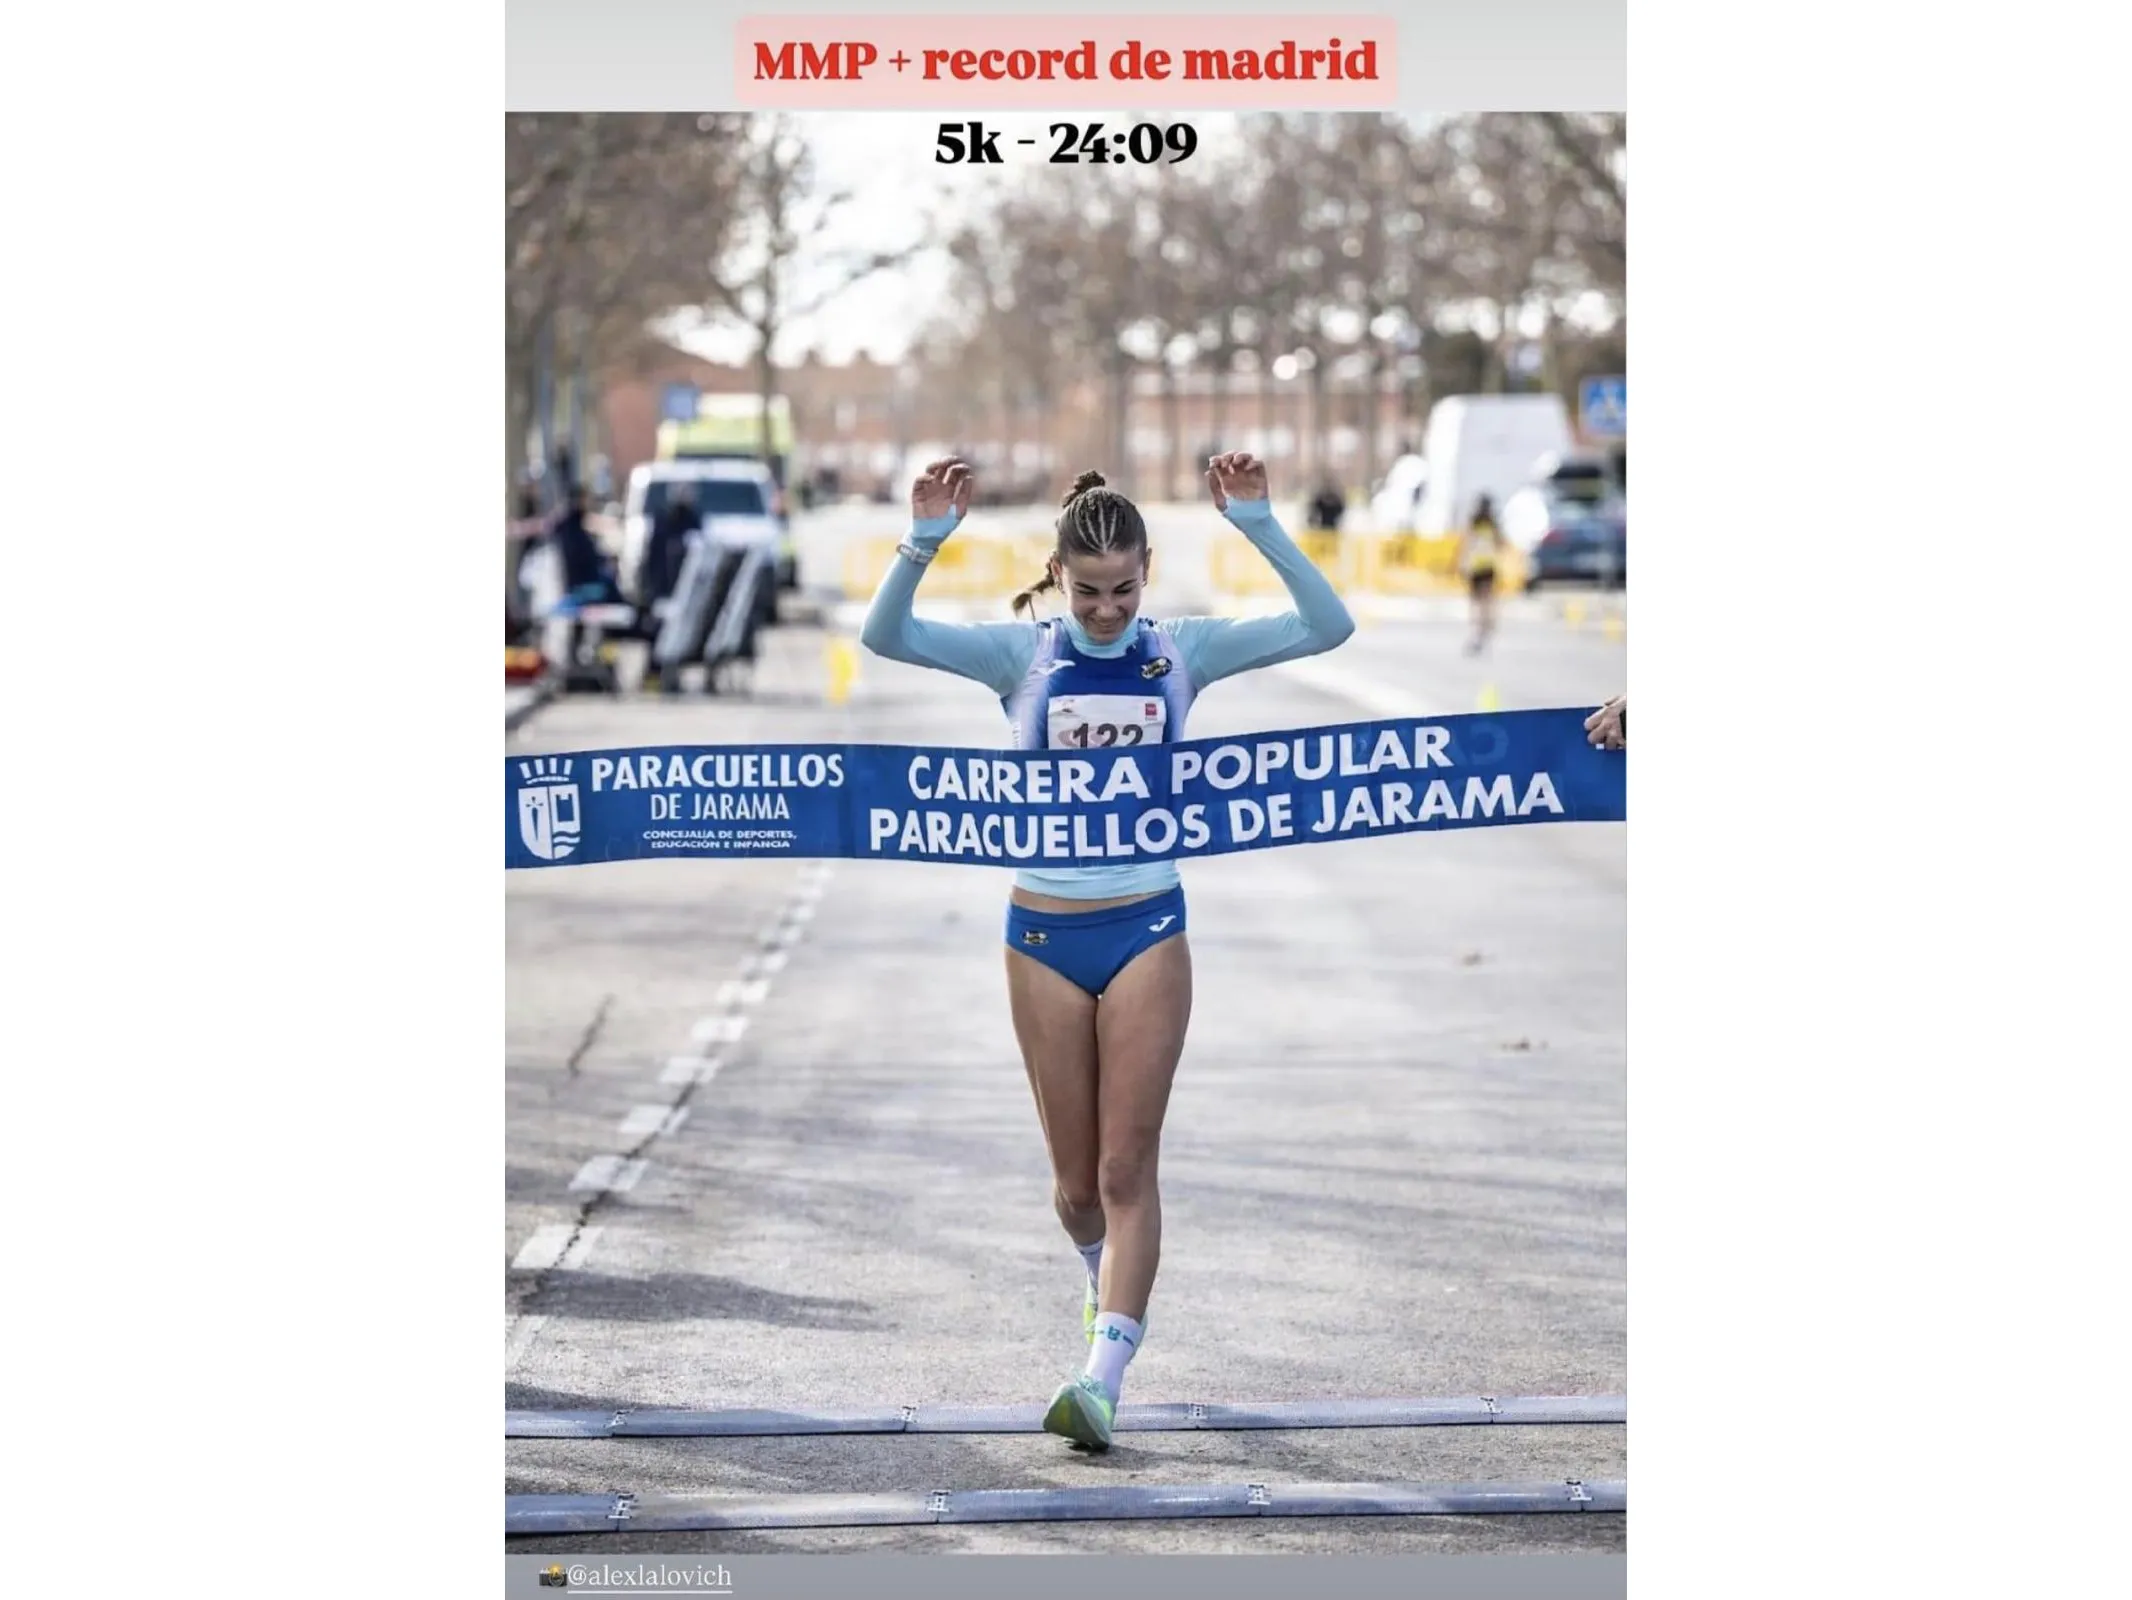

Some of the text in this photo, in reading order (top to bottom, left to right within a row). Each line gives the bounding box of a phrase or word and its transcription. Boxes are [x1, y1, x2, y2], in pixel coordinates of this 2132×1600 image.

[1072, 723, 1143, 749] 122
[591, 753, 844, 792] PARACUELLOS
[908, 755, 1151, 804] CARRERA
[1171, 726, 1454, 794] POPULAR
[650, 793, 791, 820] DE JARAMA
[870, 771, 1565, 859] PARACUELLOS DE JARAMA
[718, 830, 733, 839] DE
[733, 840, 791, 849] INFANCIA
